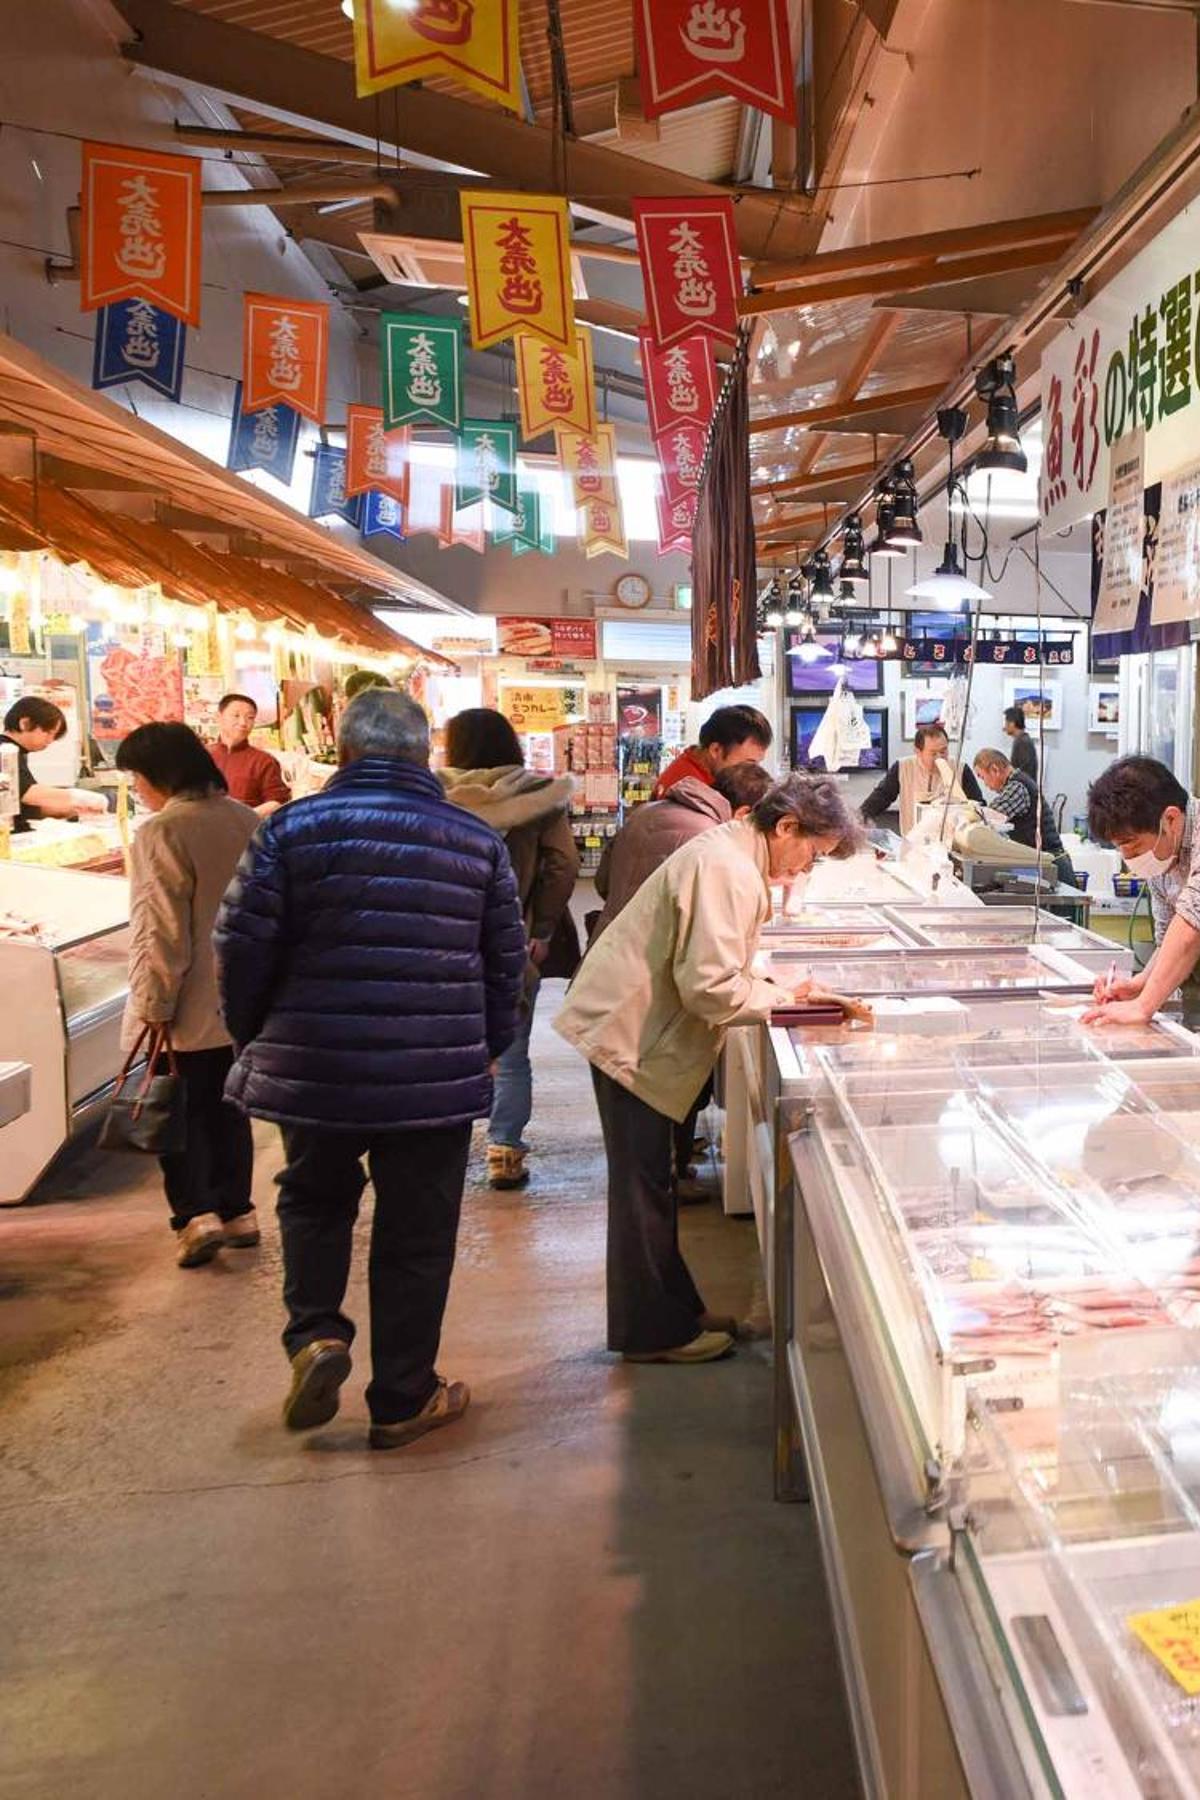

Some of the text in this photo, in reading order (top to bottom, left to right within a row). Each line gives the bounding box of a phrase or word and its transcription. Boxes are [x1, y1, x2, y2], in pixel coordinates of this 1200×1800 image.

[115, 174, 167, 279] 大売出
[494, 217, 543, 315] 大売出
[668, 221, 717, 317] 大売出
[266, 315, 303, 391] 大売出
[407, 333, 441, 405] 大売出
